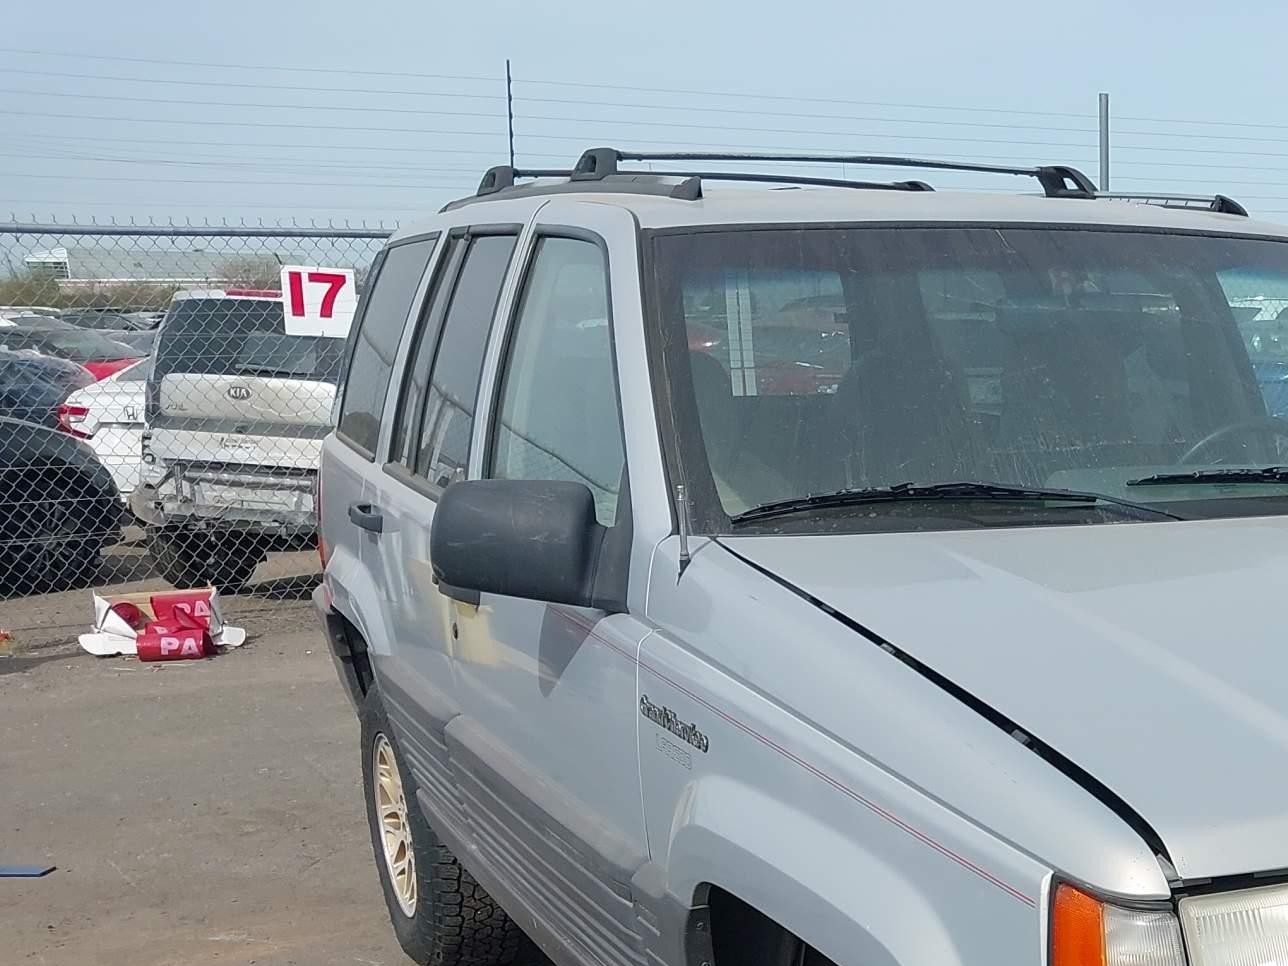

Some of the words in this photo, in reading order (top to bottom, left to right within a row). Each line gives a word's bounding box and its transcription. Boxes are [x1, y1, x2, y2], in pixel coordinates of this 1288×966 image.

[288, 271, 347, 319] 17
[229, 386, 249, 398] KIA
[160, 637, 202, 656] PA
